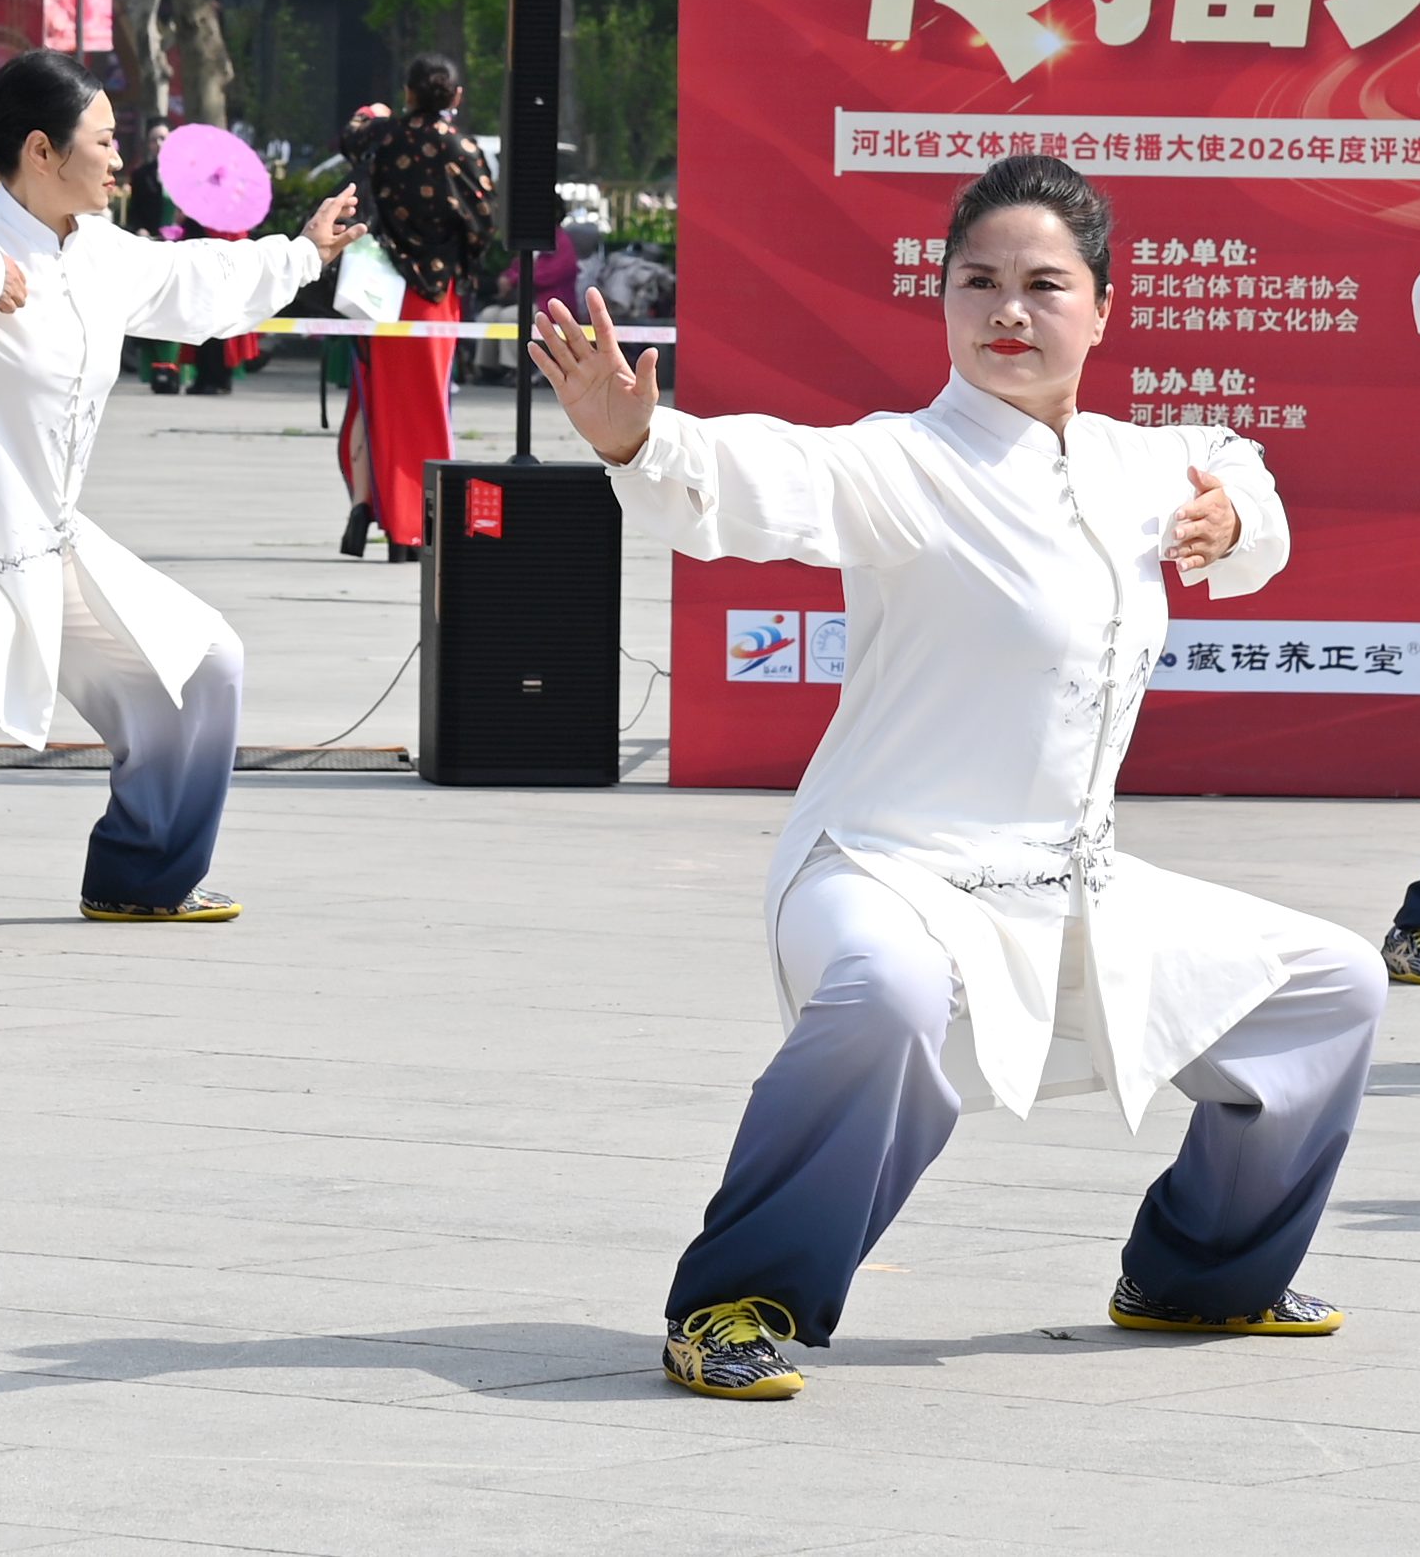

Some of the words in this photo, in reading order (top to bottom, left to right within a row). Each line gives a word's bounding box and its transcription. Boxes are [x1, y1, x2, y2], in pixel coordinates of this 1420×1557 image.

[1130, 274, 1359, 300] 河北省体育记者协会
[1130, 306, 1359, 332] 河北省体育文化协会
[1130, 403, 1307, 429] 河北藏诺养正堂
